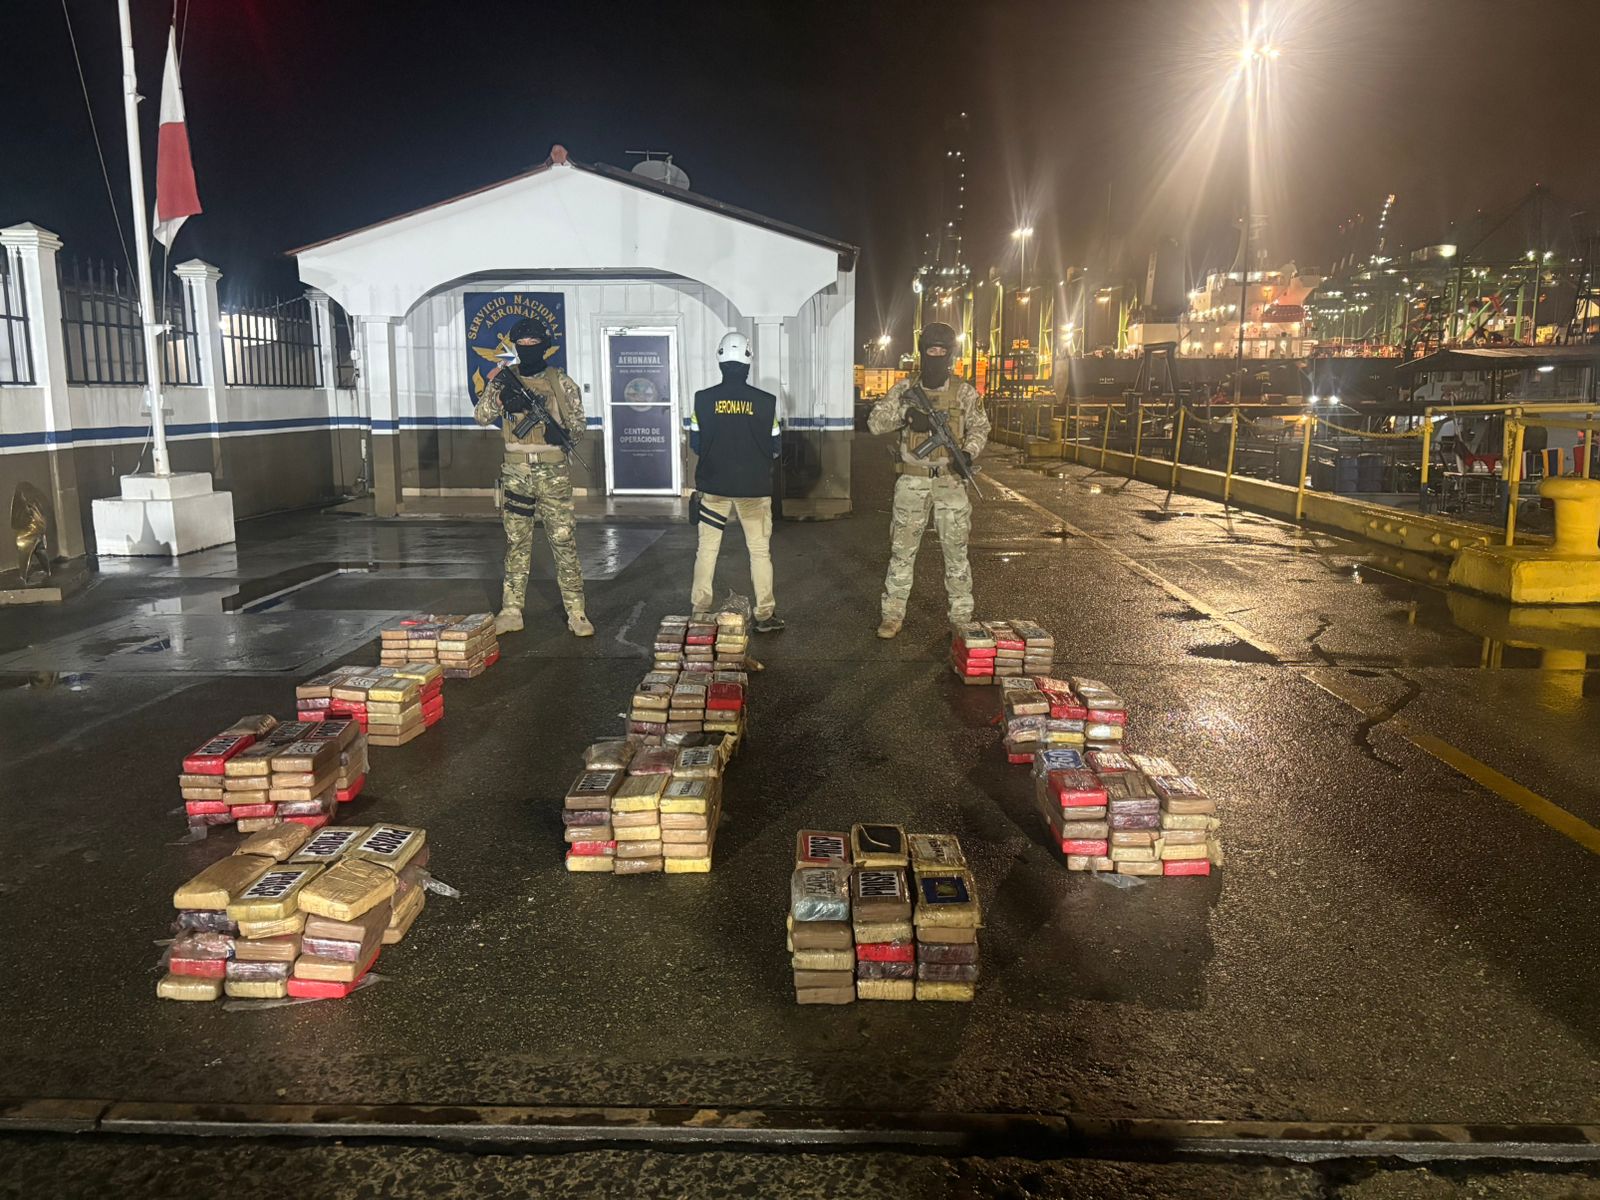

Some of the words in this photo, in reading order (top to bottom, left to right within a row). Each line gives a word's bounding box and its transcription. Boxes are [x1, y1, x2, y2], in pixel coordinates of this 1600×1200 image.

[467, 296, 506, 340] SERVICIO
[513, 294, 562, 340] NACIONAL
[618, 355, 662, 365] AERONAVAL
[714, 400, 754, 415] AERONAVAL
[623, 427, 650, 435] CENTRO
[651, 427, 661, 435] DE
[619, 435, 665, 443] OPERACIONES
[363, 827, 413, 855] PROSP
[860, 871, 898, 896] PROSP
